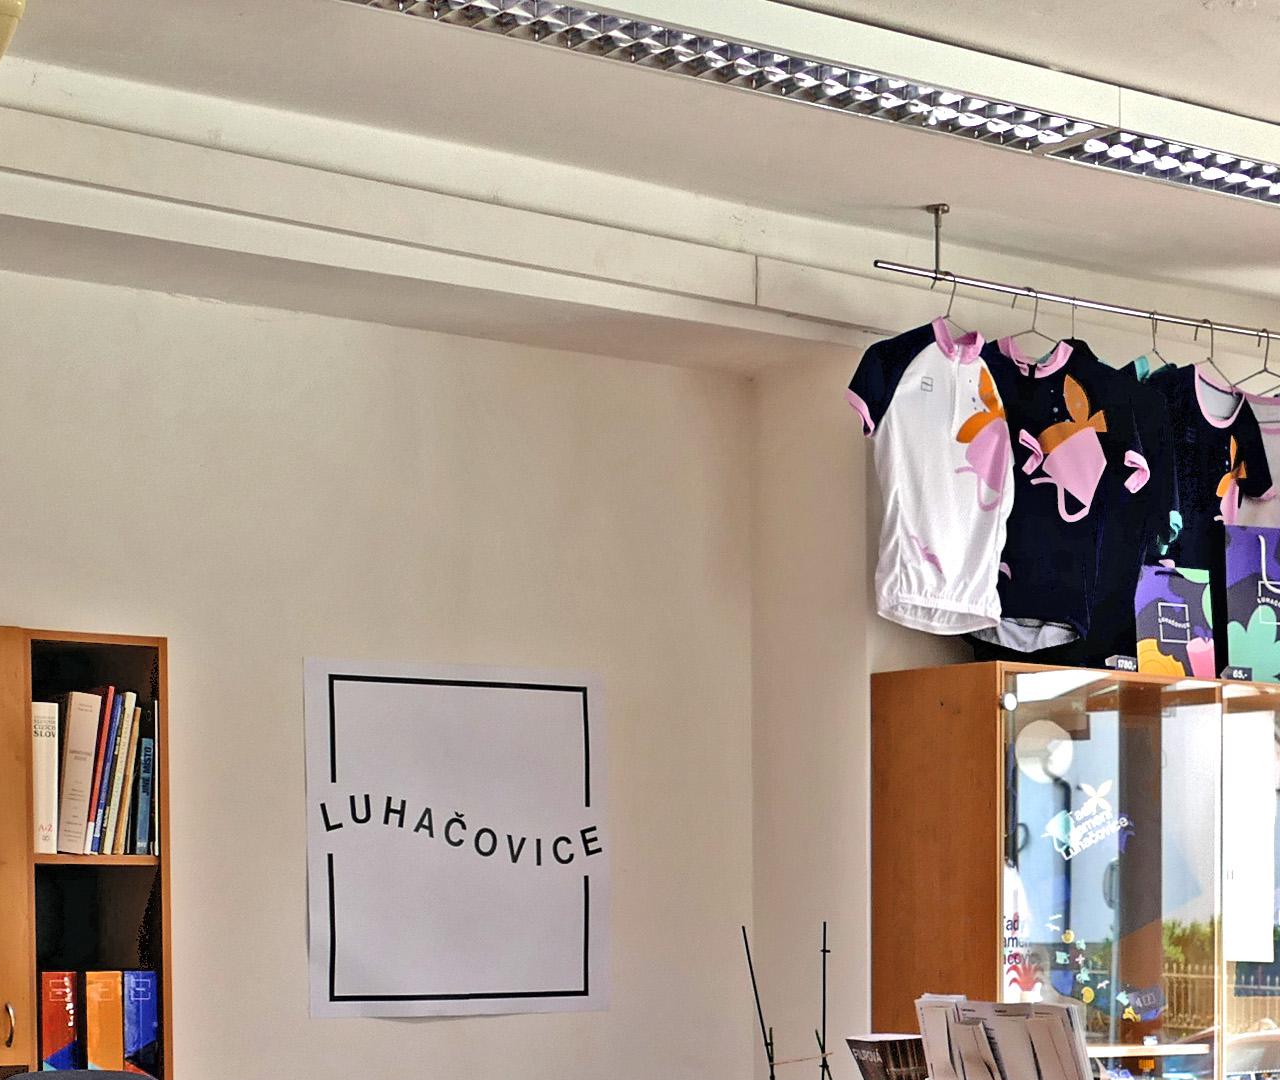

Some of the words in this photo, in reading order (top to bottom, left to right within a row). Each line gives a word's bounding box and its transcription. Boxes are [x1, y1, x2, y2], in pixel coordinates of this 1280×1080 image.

[1232, 669, 1249, 679] 65,-
[142, 746, 153, 775] MÍSTO
[320, 793, 603, 866] LUHAČOVICE
